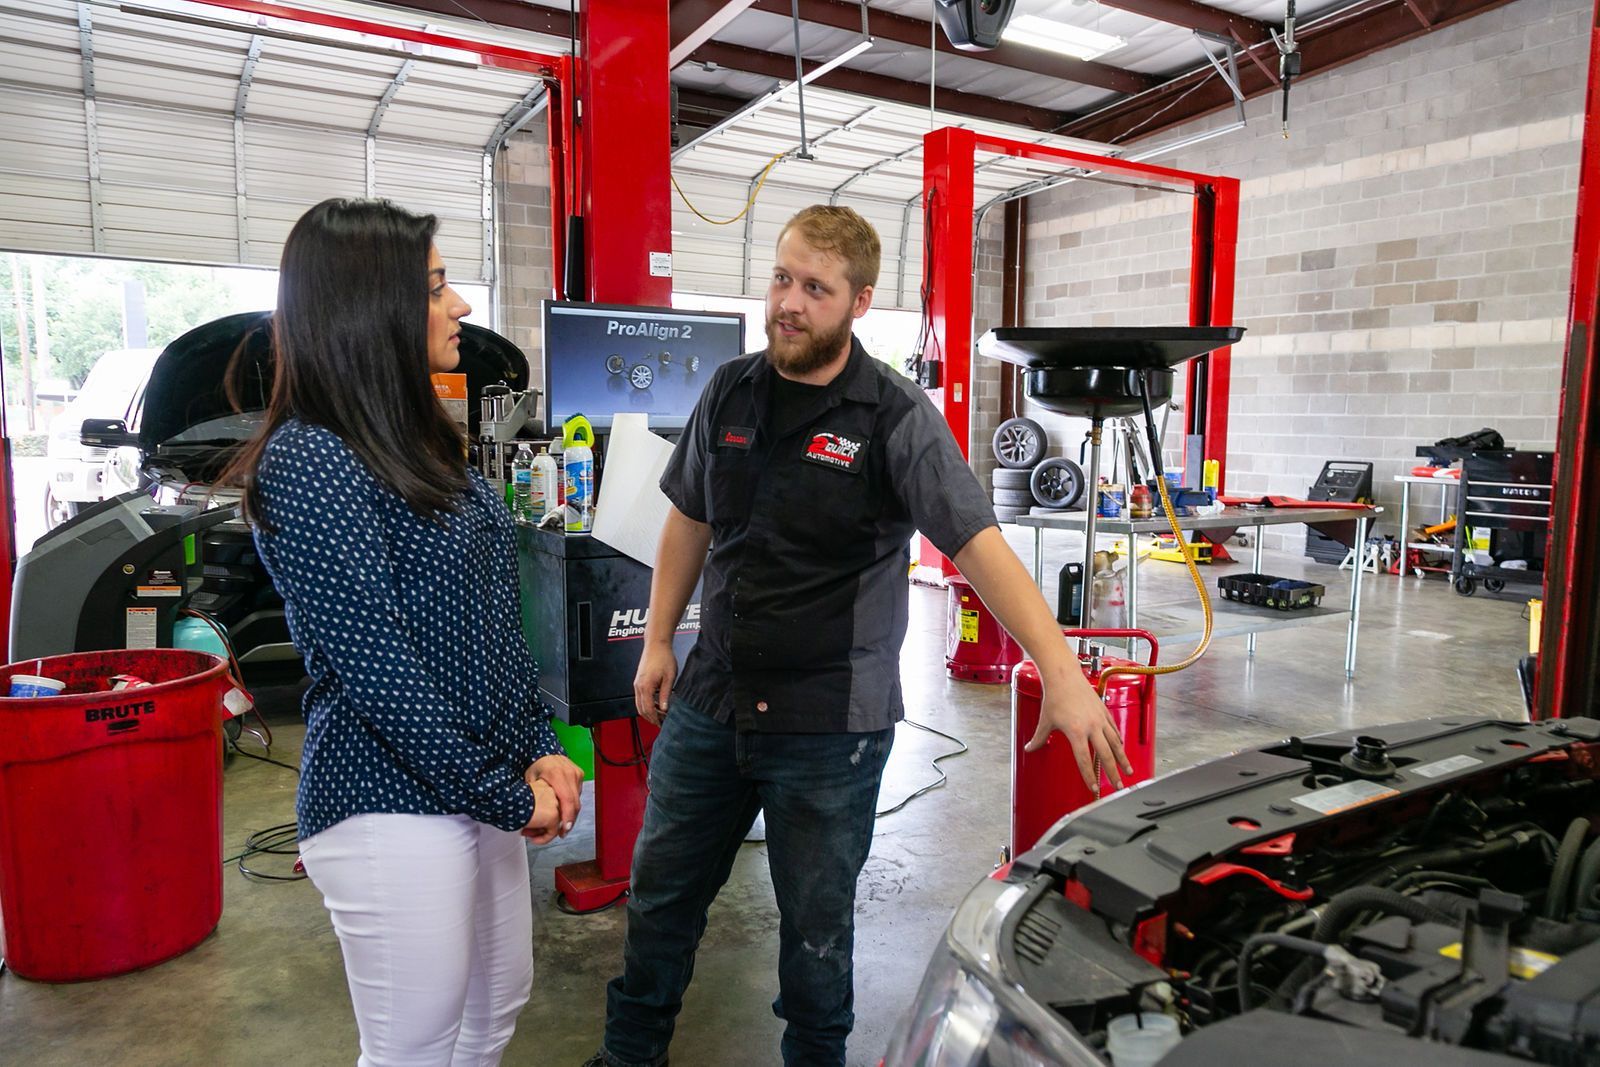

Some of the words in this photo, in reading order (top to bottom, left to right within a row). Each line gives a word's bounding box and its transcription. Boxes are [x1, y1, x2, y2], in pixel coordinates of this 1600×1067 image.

[607, 320, 679, 340] ProAlign
[680, 324, 693, 339] 2
[806, 451, 850, 468] AUTOMOTIVE
[825, 442, 858, 459] QUICK
[610, 603, 701, 626] HUE
[608, 626, 645, 637] Engine
[85, 701, 155, 722] BRUTE
